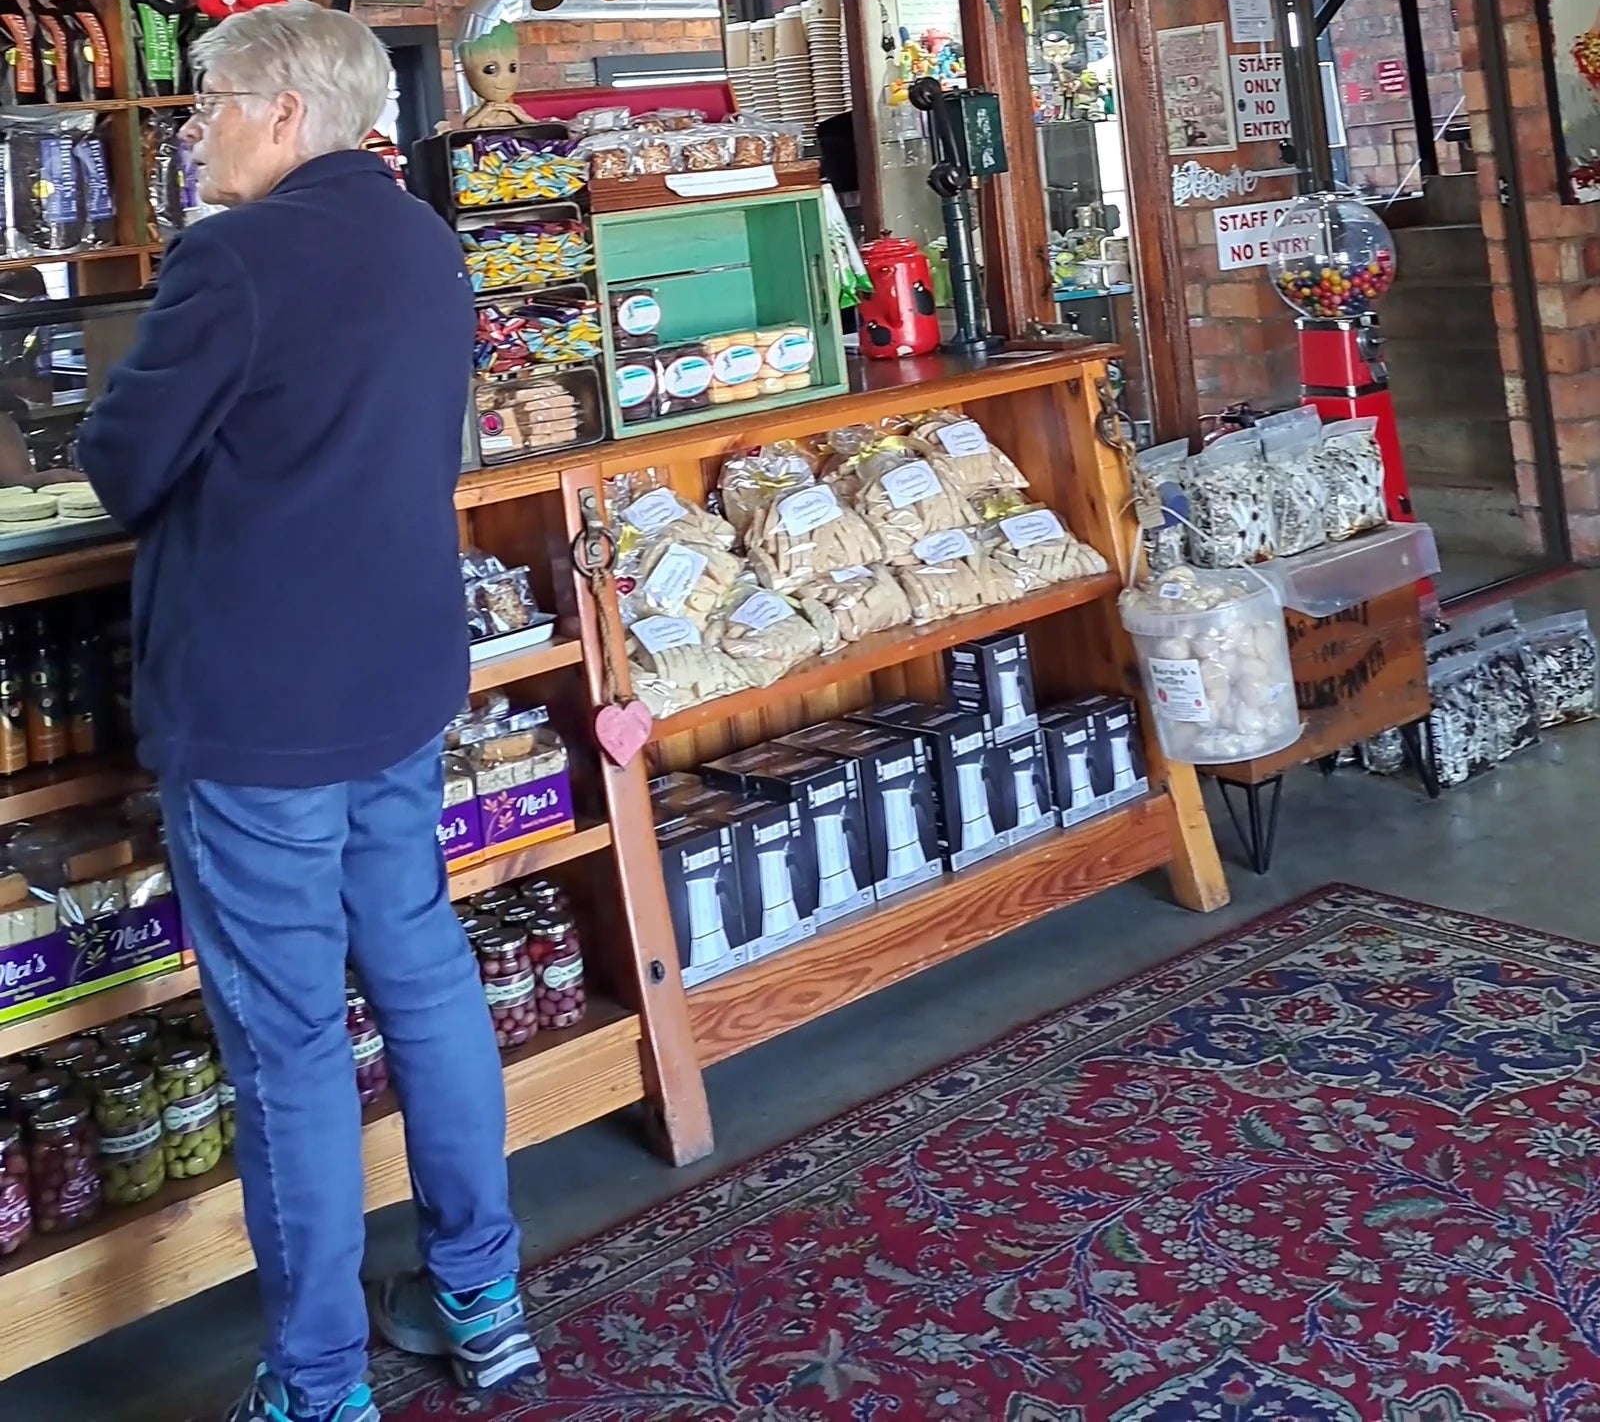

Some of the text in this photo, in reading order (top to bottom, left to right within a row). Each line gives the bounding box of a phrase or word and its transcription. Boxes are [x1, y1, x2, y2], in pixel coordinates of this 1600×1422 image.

[1239, 57, 1282, 73] STAFF
[1244, 78, 1281, 94] ONLY
[1255, 100, 1276, 115] NO
[1243, 120, 1291, 137] ENTRY
[1219, 210, 1268, 231] STAFF
[1230, 236, 1312, 262] NO ENTRY
[436, 817, 468, 846] ici's
